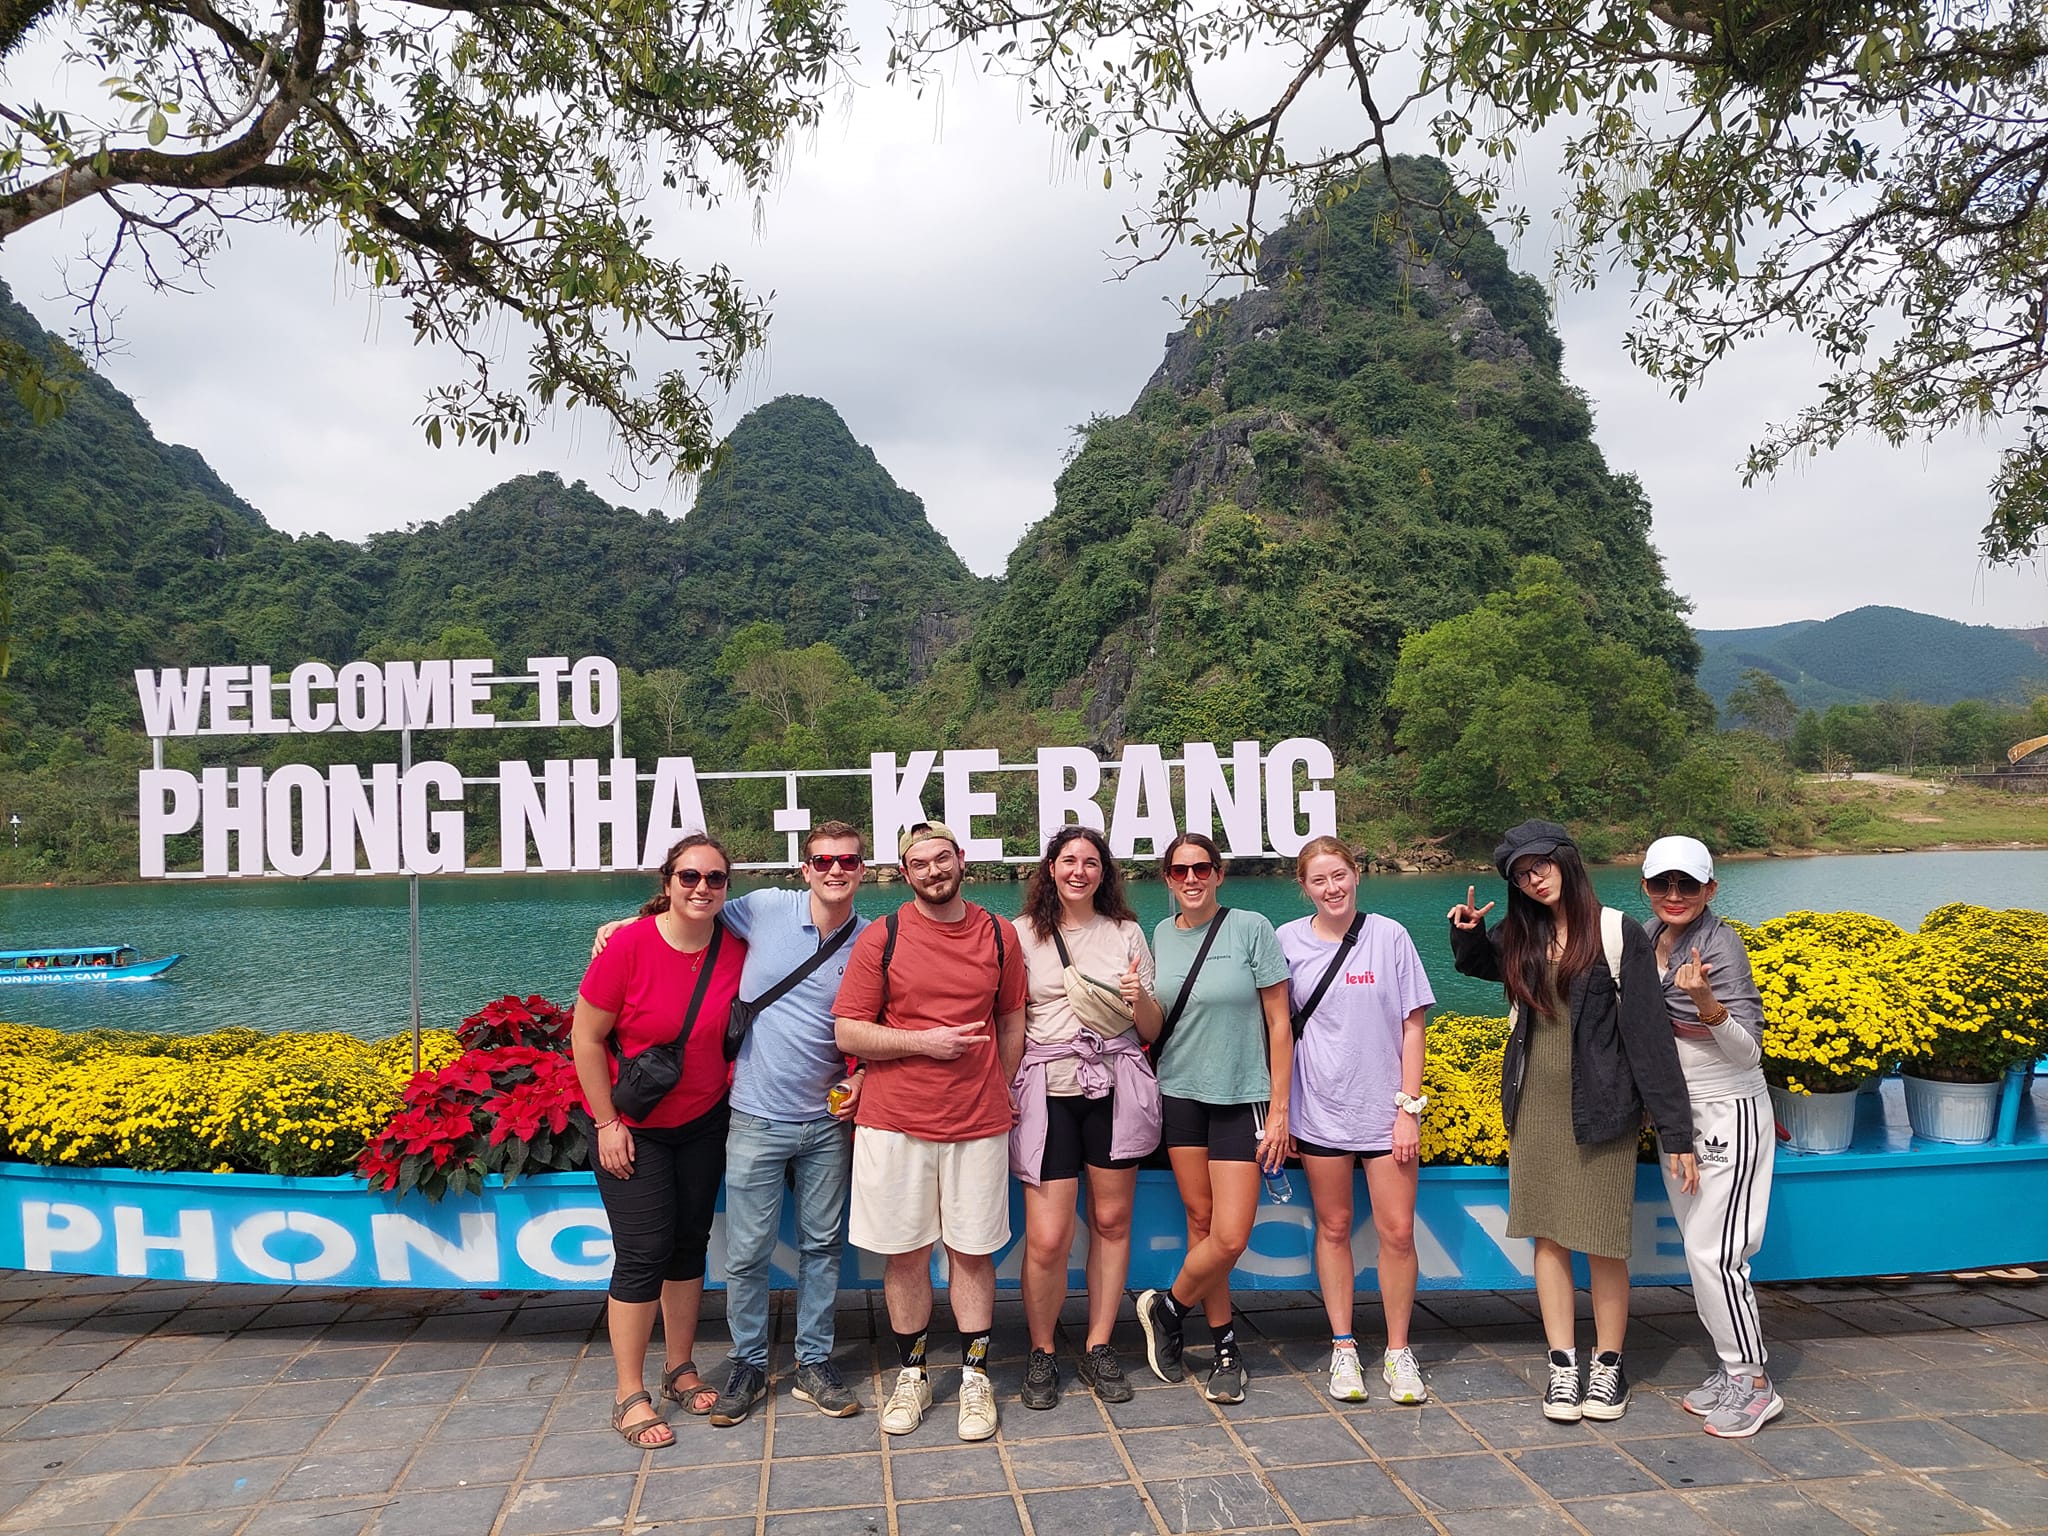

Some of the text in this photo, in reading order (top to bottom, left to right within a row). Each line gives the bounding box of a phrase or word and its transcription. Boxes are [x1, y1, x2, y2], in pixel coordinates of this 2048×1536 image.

[134, 656, 619, 737] WELCOME TO
[139, 761, 466, 877] PHONG
[500, 756, 709, 872] NHA
[870, 748, 1004, 865] KE
[1037, 737, 1338, 859] BANG
[33, 974, 62, 982] NHA
[75, 972, 108, 980] CAVE
[1702, 1153, 1729, 1163] adidas
[22, 1201, 617, 1282] PHONG
